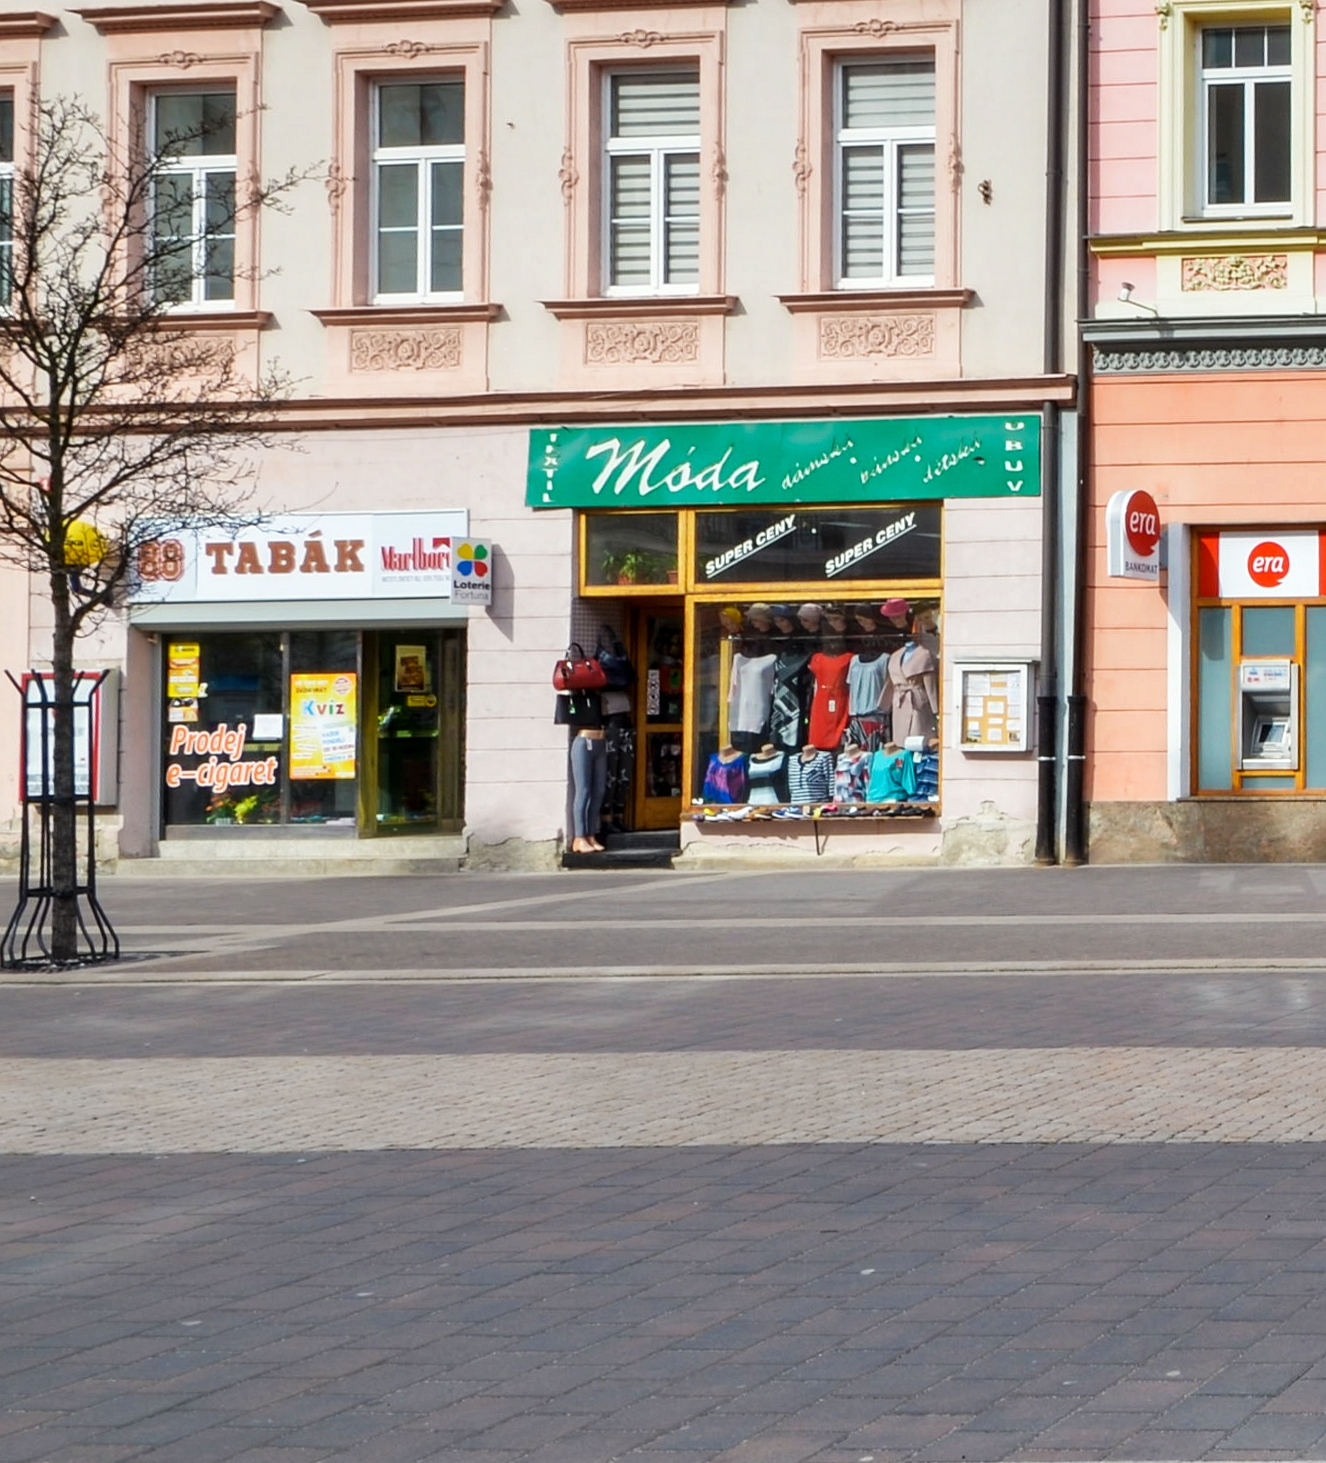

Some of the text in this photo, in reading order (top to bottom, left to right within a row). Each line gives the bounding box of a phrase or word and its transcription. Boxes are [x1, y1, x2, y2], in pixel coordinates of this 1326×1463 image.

[585, 437, 766, 496] Móda
[1129, 511, 1156, 535] era
[205, 530, 364, 574] TABÁK
[705, 514, 796, 575] SUPER CENY
[825, 512, 916, 574] SUPER CENY
[1125, 561, 1158, 575] BANKOMAT
[1252, 556, 1284, 573] era
[453, 580, 490, 590] Loterie
[454, 590, 489, 600] Fortuna
[169, 723, 248, 761] Prodej
[166, 756, 279, 793] e-cigaret
